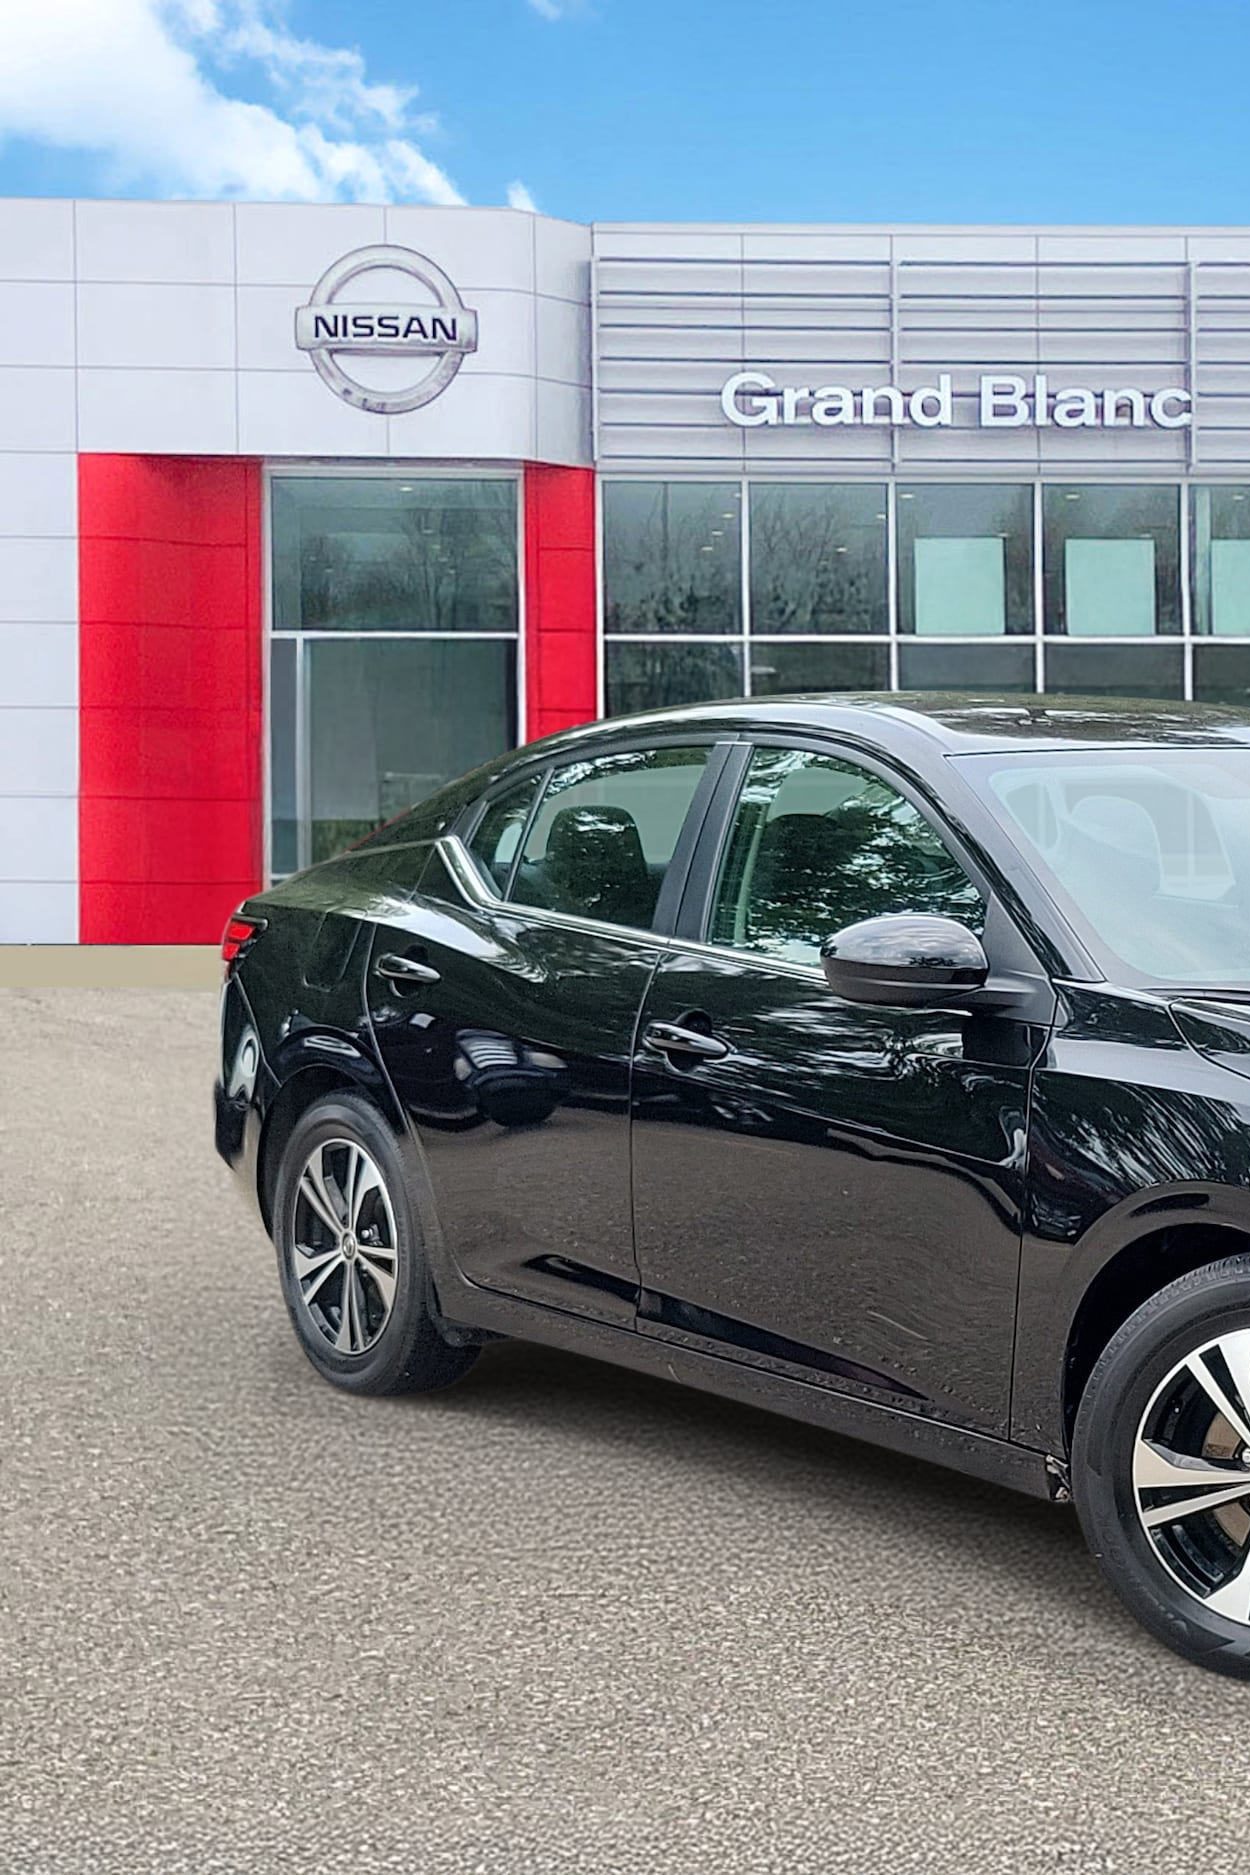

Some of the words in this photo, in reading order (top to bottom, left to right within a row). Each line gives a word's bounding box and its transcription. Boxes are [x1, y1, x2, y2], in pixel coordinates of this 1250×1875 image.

[314, 315, 457, 341] NISSAN
[720, 372, 953, 427] Grand
[979, 374, 1193, 428] Blanc
